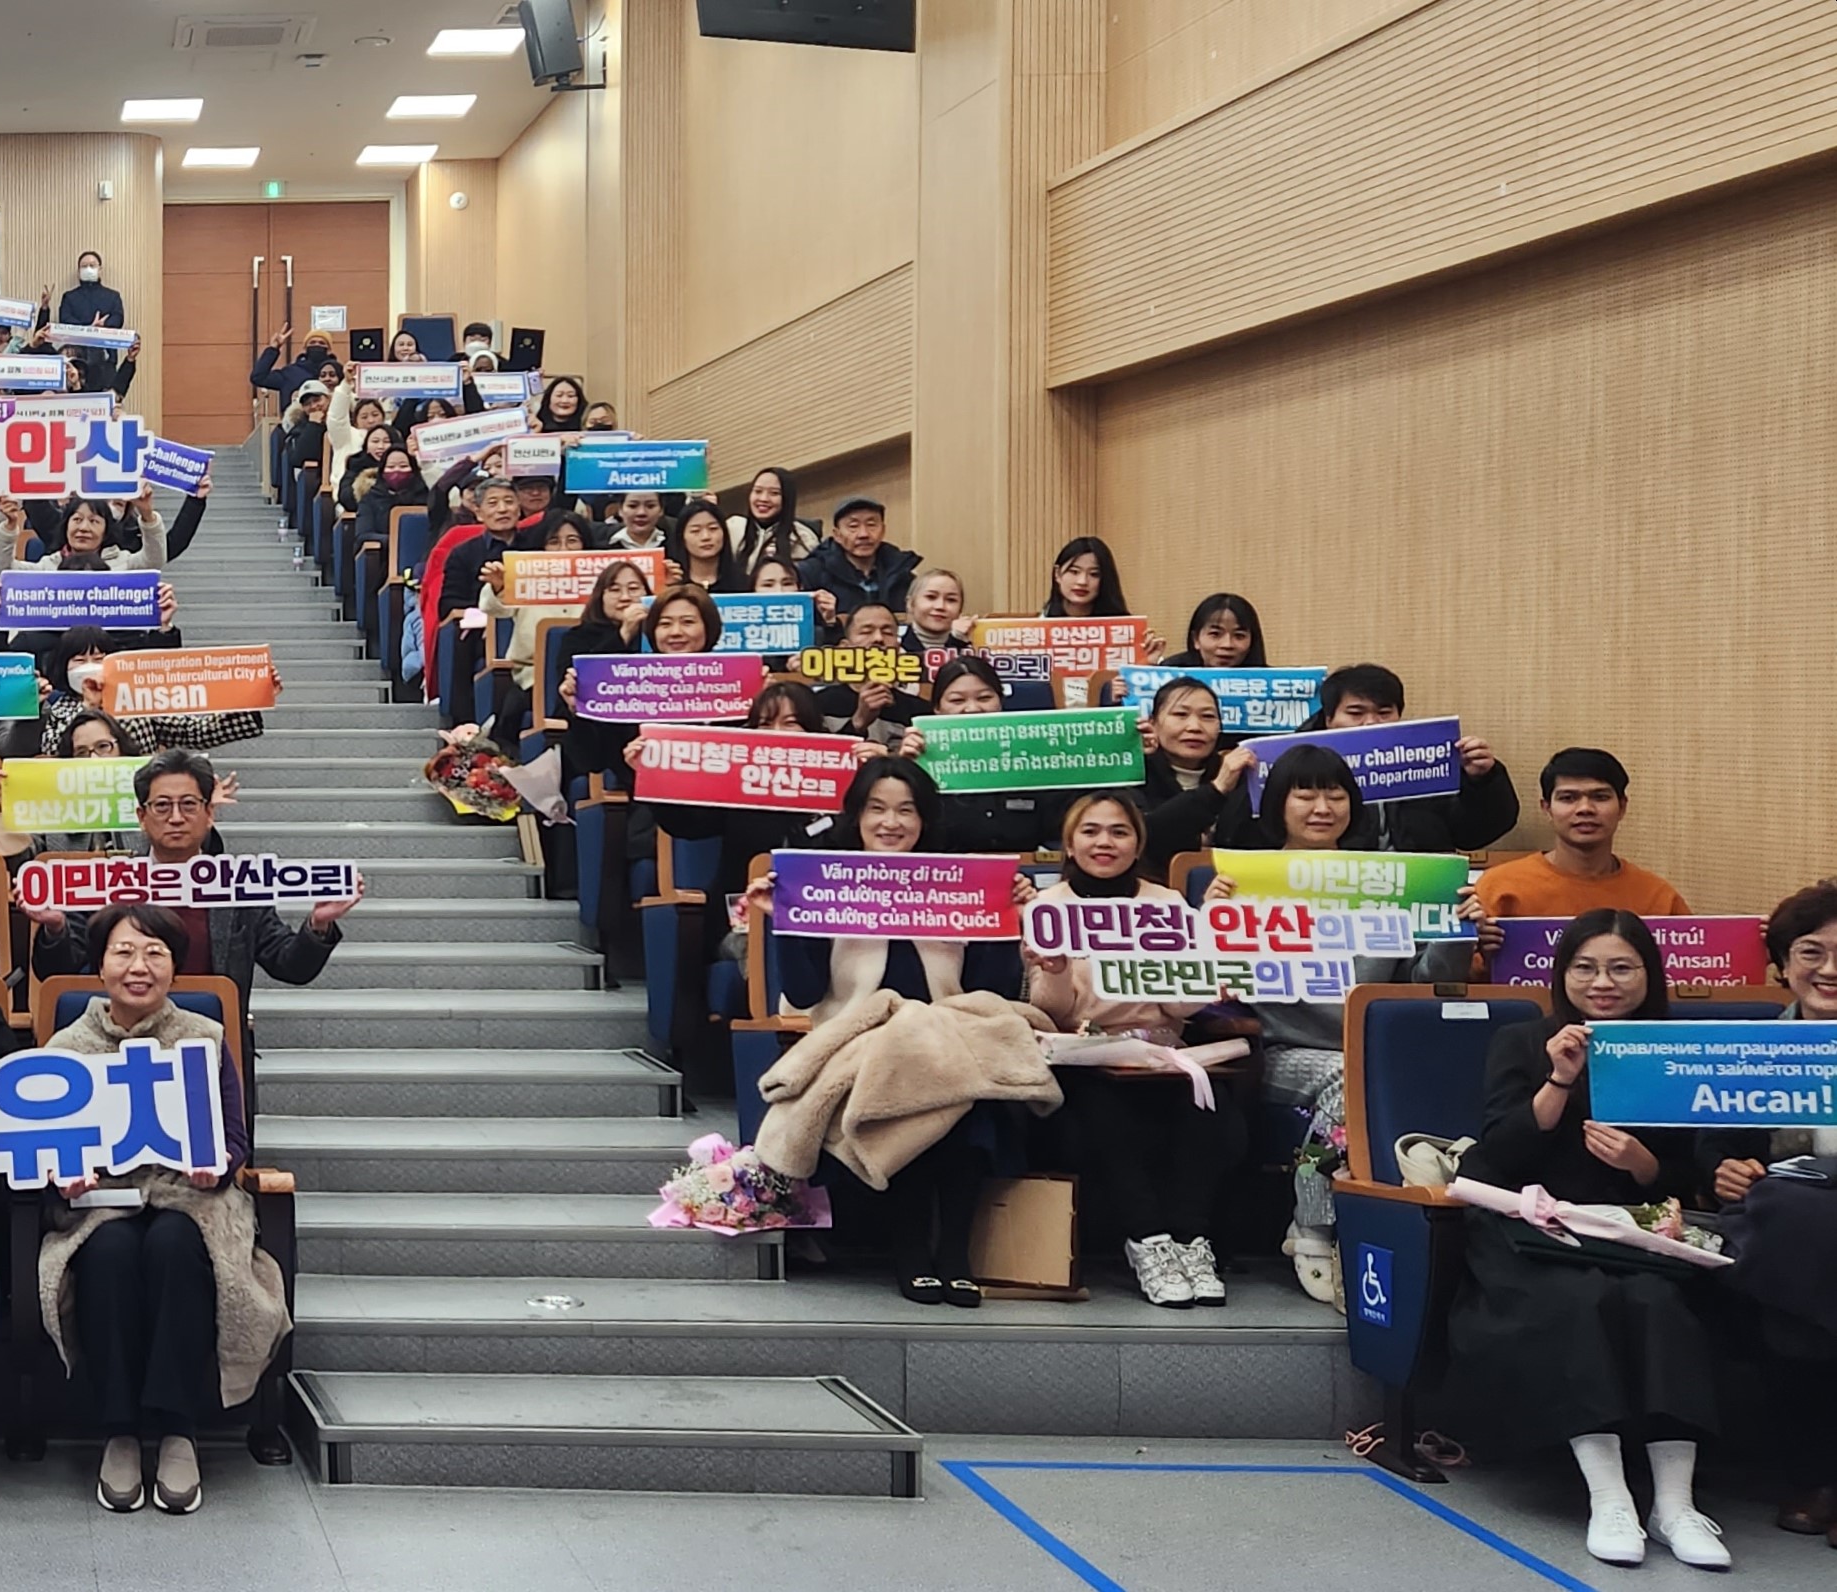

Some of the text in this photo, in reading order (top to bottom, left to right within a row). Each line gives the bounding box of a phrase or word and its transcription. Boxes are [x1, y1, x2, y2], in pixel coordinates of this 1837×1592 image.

[6, 419, 148, 494] 안산
[607, 470, 667, 486] Ансан!
[6, 587, 154, 603] Ansan's new challenge!
[6, 604, 153, 619] The Immigration Department!
[985, 625, 1134, 646] 이민청! 안산의 길!
[115, 653, 269, 672] The Immigration Department
[802, 648, 922, 682] 이민청은
[1105, 647, 1135, 670] 길!
[166, 665, 269, 683] Intercultural City of
[114, 682, 208, 712] Ansan
[1271, 678, 1316, 698] 도전!
[1245, 700, 1311, 727] 함께!
[641, 738, 858, 774] 이민청은 상호문화도시
[1364, 740, 1451, 767] challenge!
[740, 765, 837, 798] 안산으로
[1369, 763, 1449, 786] Department!
[22, 859, 352, 906] 이민청은 안산으로!
[913, 864, 929, 882] di
[932, 864, 964, 883] trú!
[1286, 859, 1406, 897] 이민청!
[802, 885, 836, 902] Con
[893, 886, 925, 903] của
[927, 888, 985, 905] Ansan!
[789, 907, 823, 923] Con
[880, 907, 911, 926] của
[913, 909, 946, 927] Hàn
[1032, 903, 1410, 954] 이민청! 안산의 길!
[1665, 952, 1730, 970] Ansan!
[1100, 959, 1351, 998] 대한민국의 길!
[1593, 1040, 1702, 1059] Управление
[1664, 1060, 1713, 1076] Этим
[1691, 1084, 1833, 1114] Ансан!
